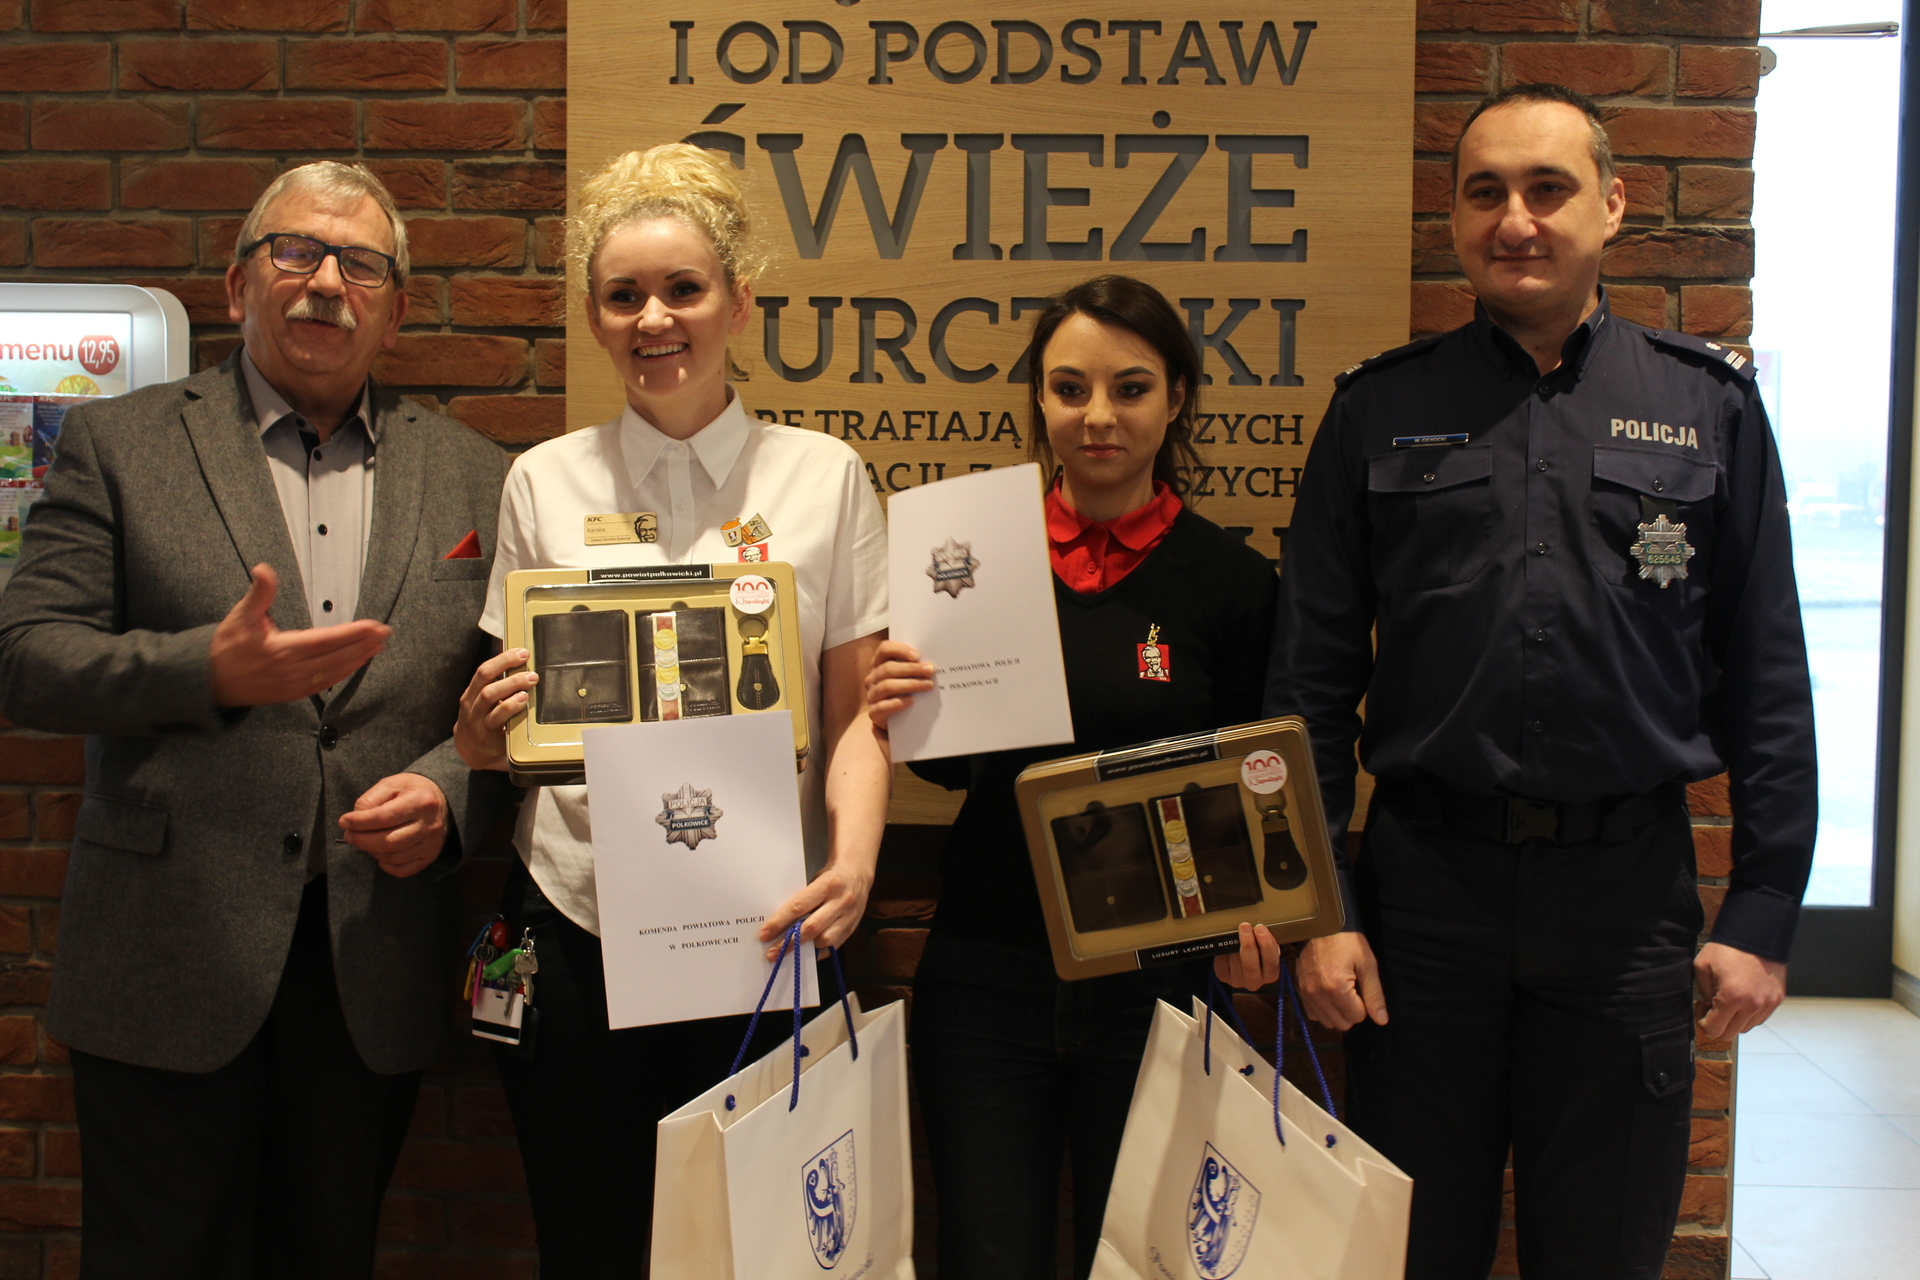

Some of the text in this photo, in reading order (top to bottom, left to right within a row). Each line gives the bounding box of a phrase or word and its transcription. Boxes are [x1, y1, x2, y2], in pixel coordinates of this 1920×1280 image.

[669, 19, 1318, 85] I OD PODSTAW
[0, 343, 74, 361] menu
[81, 339, 116, 369] 12,95
[814, 409, 1023, 449] TRAFIAJĄ
[1610, 417, 1699, 450] POLICJA
[600, 570, 703, 579] www.powiatpolkowicki.pl
[670, 799, 706, 808] POLICJA
[672, 819, 709, 829] POLKOWICE
[639, 916, 765, 936] KOMENDA POWIATOWA POLICJI
[681, 937, 739, 949] POLKOWICACH
[1152, 939, 1239, 958] LUXURY LEATHER GOOD
